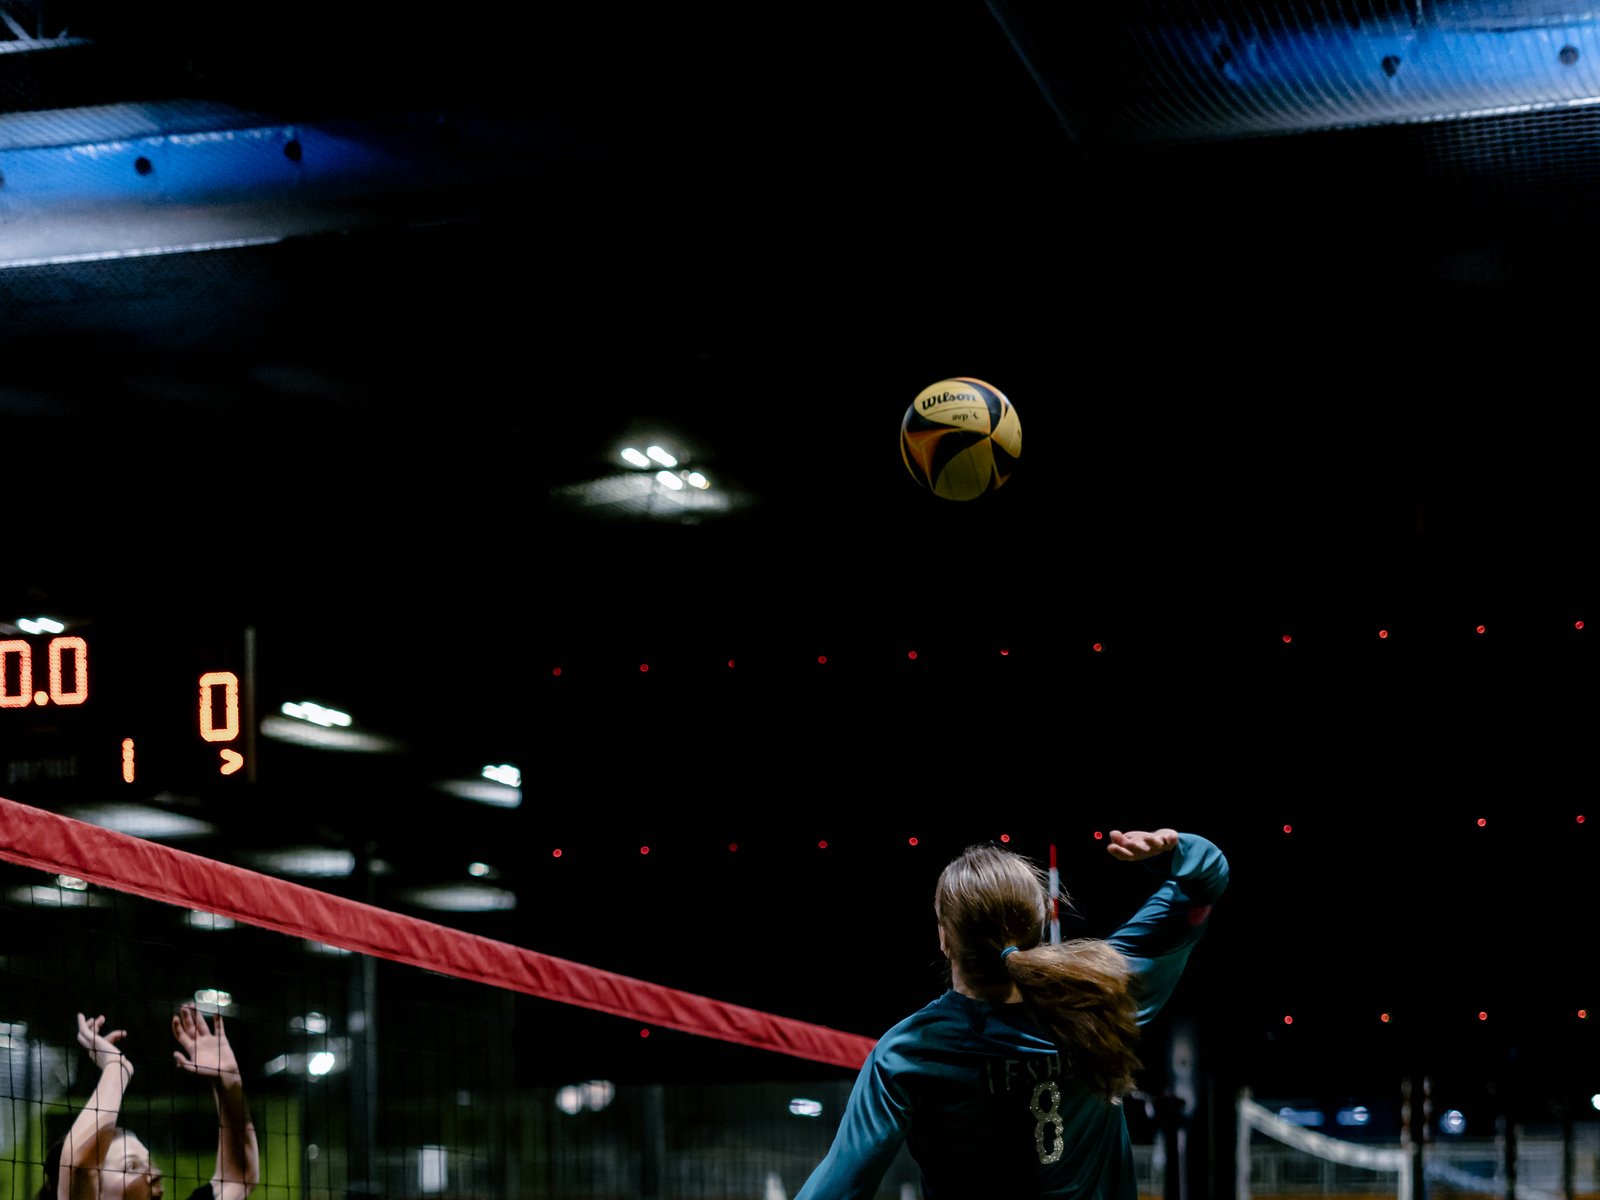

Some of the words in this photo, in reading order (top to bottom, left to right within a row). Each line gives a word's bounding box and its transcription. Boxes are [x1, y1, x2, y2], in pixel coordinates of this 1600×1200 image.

[922, 392, 976, 410] Wilson
[0, 636, 88, 708] 0.0
[199, 671, 239, 742] 0
[1029, 1080, 1065, 1165] 8
